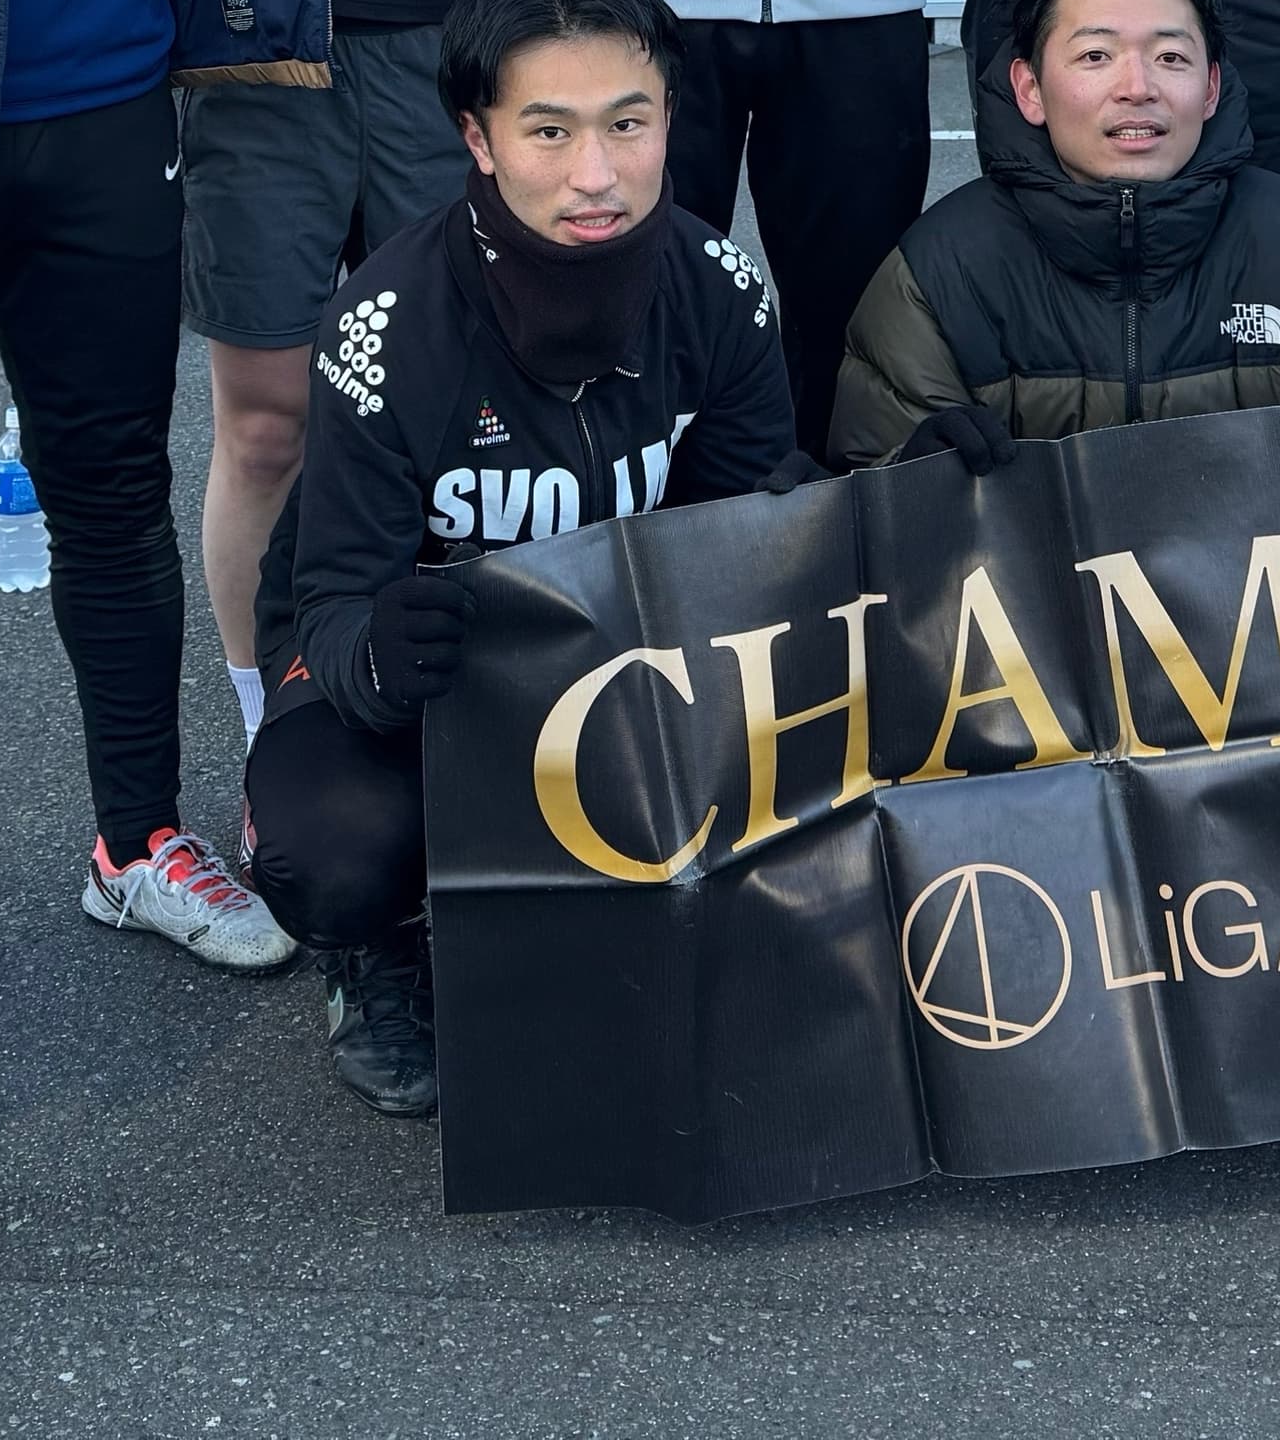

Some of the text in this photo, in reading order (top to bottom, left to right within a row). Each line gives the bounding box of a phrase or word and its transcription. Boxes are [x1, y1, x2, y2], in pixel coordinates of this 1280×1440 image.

[1232, 303, 1264, 318] THE
[1232, 329, 1266, 344] FACE
[317, 351, 384, 413] svolme
